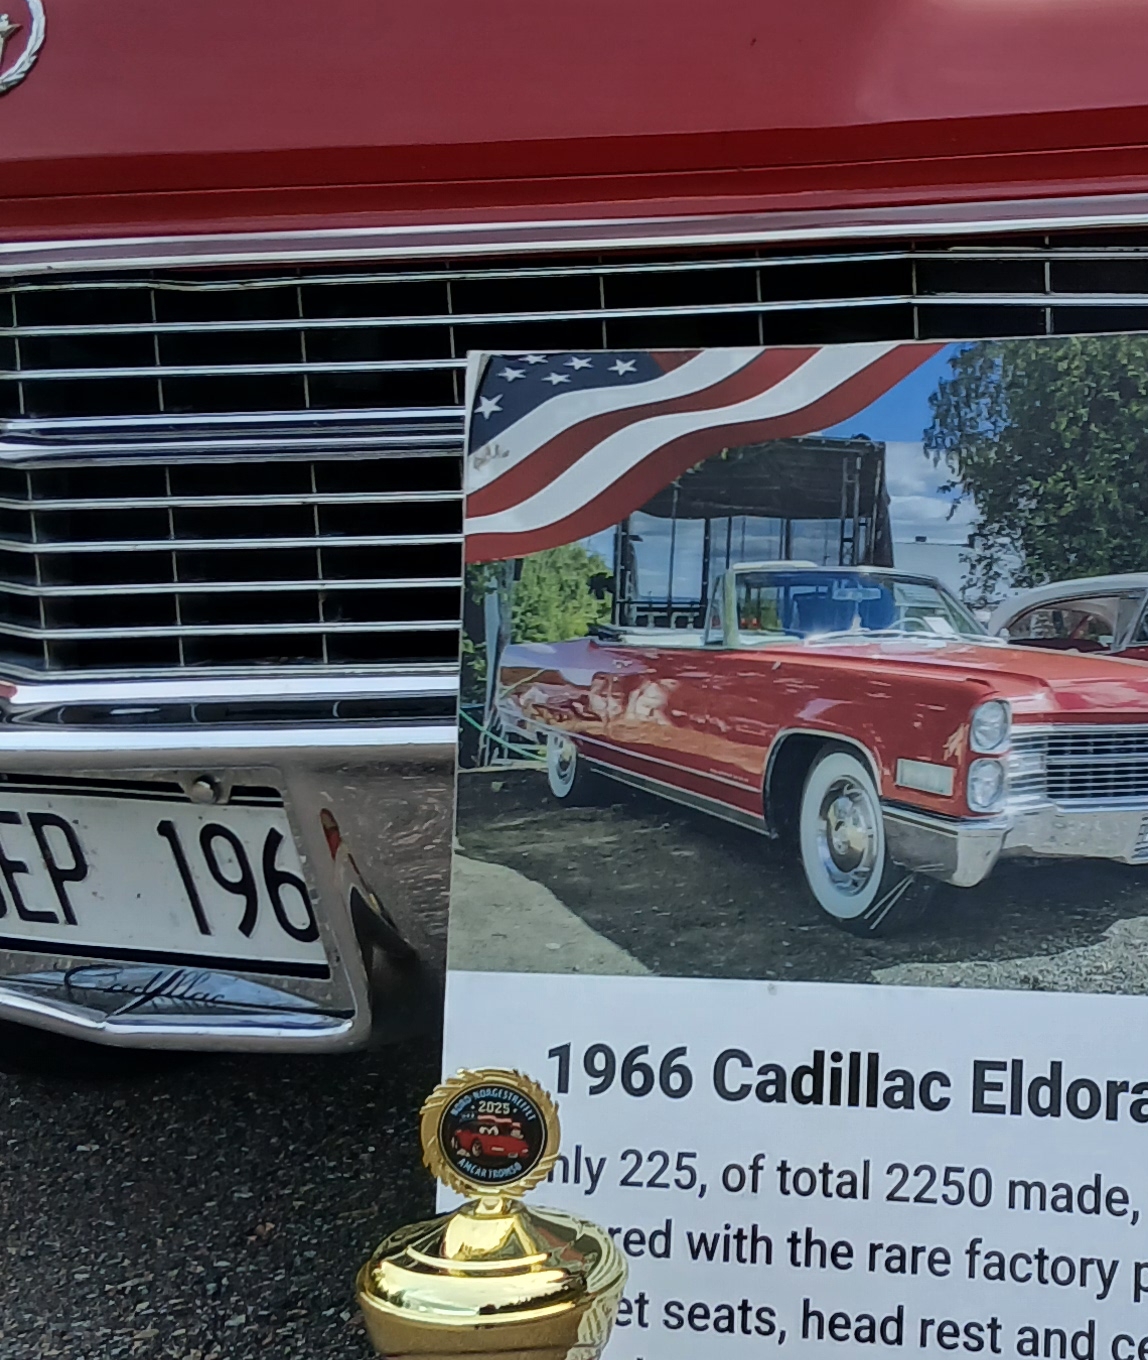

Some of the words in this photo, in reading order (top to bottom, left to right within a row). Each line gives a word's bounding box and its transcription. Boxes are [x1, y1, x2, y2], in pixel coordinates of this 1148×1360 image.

[0, 809, 88, 926] EP
[157, 819, 320, 943] 196
[478, 1100, 511, 1115] 2025
[548, 1042, 693, 1099] 1966
[713, 1049, 951, 1112] Cadillac
[547, 1145, 606, 1195] nly
[619, 1149, 706, 1198] 225,
[722, 1153, 765, 1194] of
[776, 1159, 870, 1200] total
[886, 1163, 992, 1207] 2250
[1008, 1173, 1139, 1226] made,
[686, 1223, 772, 1265] with
[787, 1227, 853, 1270] the
[869, 1242, 951, 1277] rare
[965, 1238, 1119, 1300] factory
[663, 1299, 786, 1345] seats,
[802, 1298, 904, 1346] head
[920, 1317, 1002, 1354] rest
